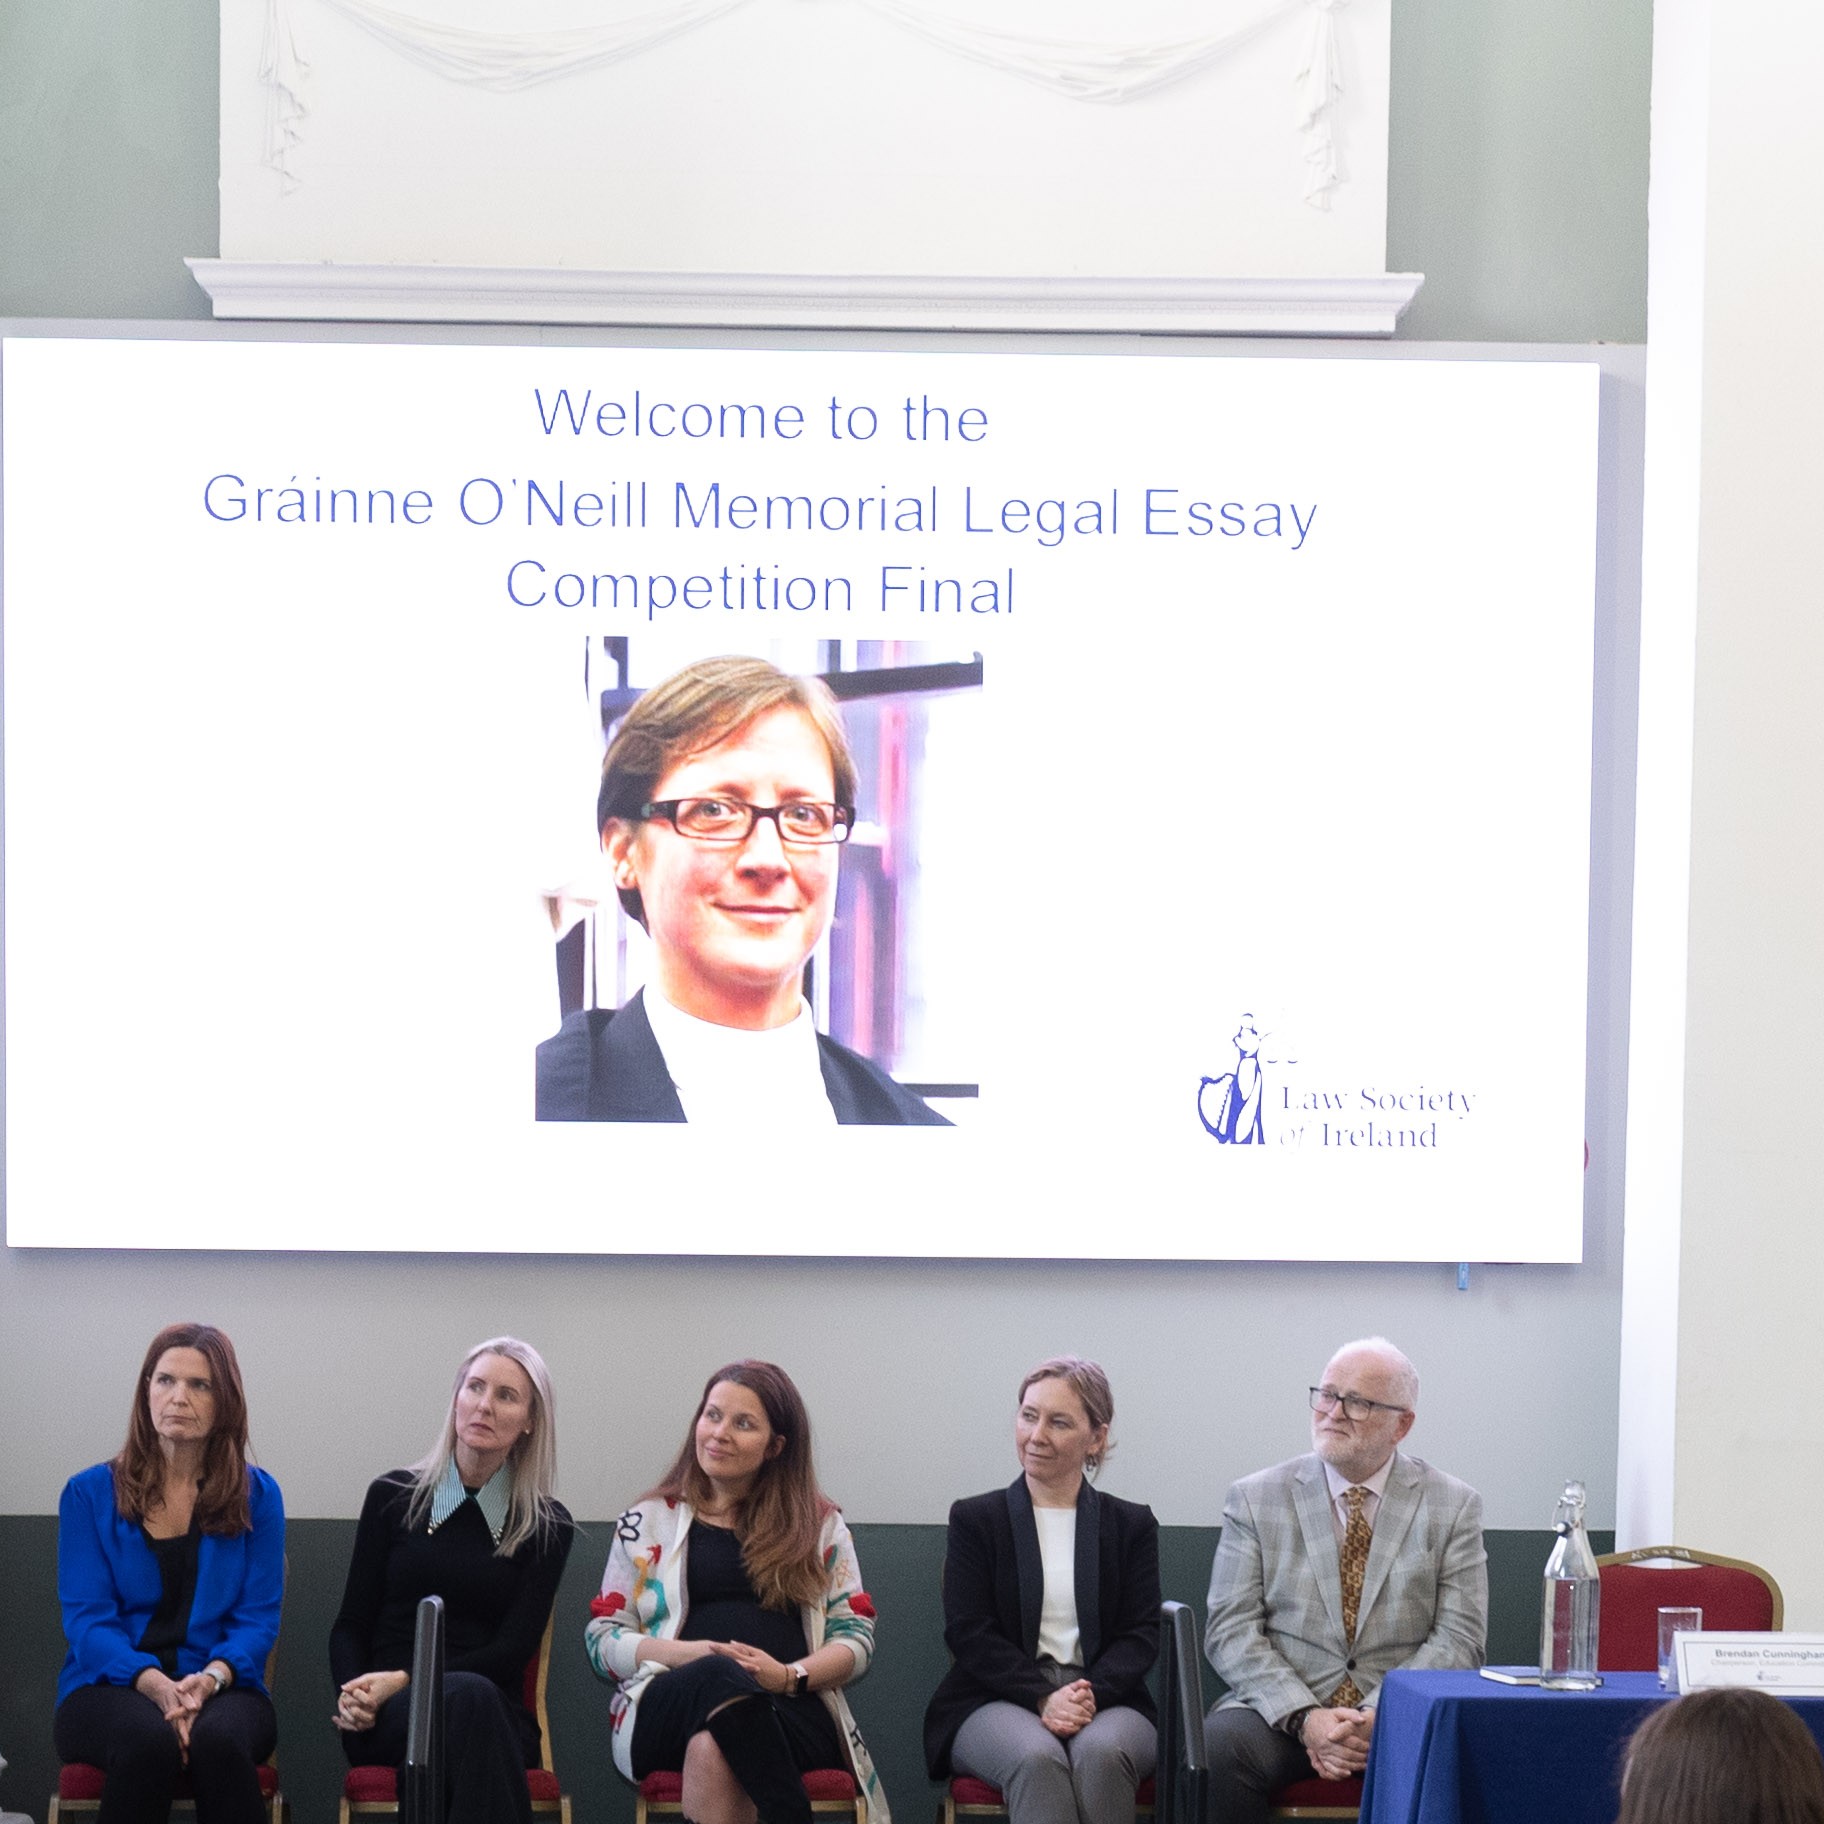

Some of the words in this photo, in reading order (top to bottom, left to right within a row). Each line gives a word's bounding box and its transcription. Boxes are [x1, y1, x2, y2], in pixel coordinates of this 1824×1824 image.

[533, 388, 805, 440] Welcome
[827, 395, 878, 441] to
[902, 394, 989, 442] the
[203, 473, 434, 525] Gráinne
[459, 477, 646, 528] O'Neill
[675, 481, 937, 532] Memorial
[965, 486, 1118, 548] Legal
[1145, 488, 1318, 551] Essay
[506, 559, 851, 622] Competition
[881, 565, 1013, 614] Final
[1282, 1086, 1351, 1110] Law
[1360, 1085, 1476, 1120] Society
[1322, 1121, 1437, 1148] Ireland
[1714, 1648, 1760, 1659] Brendan
